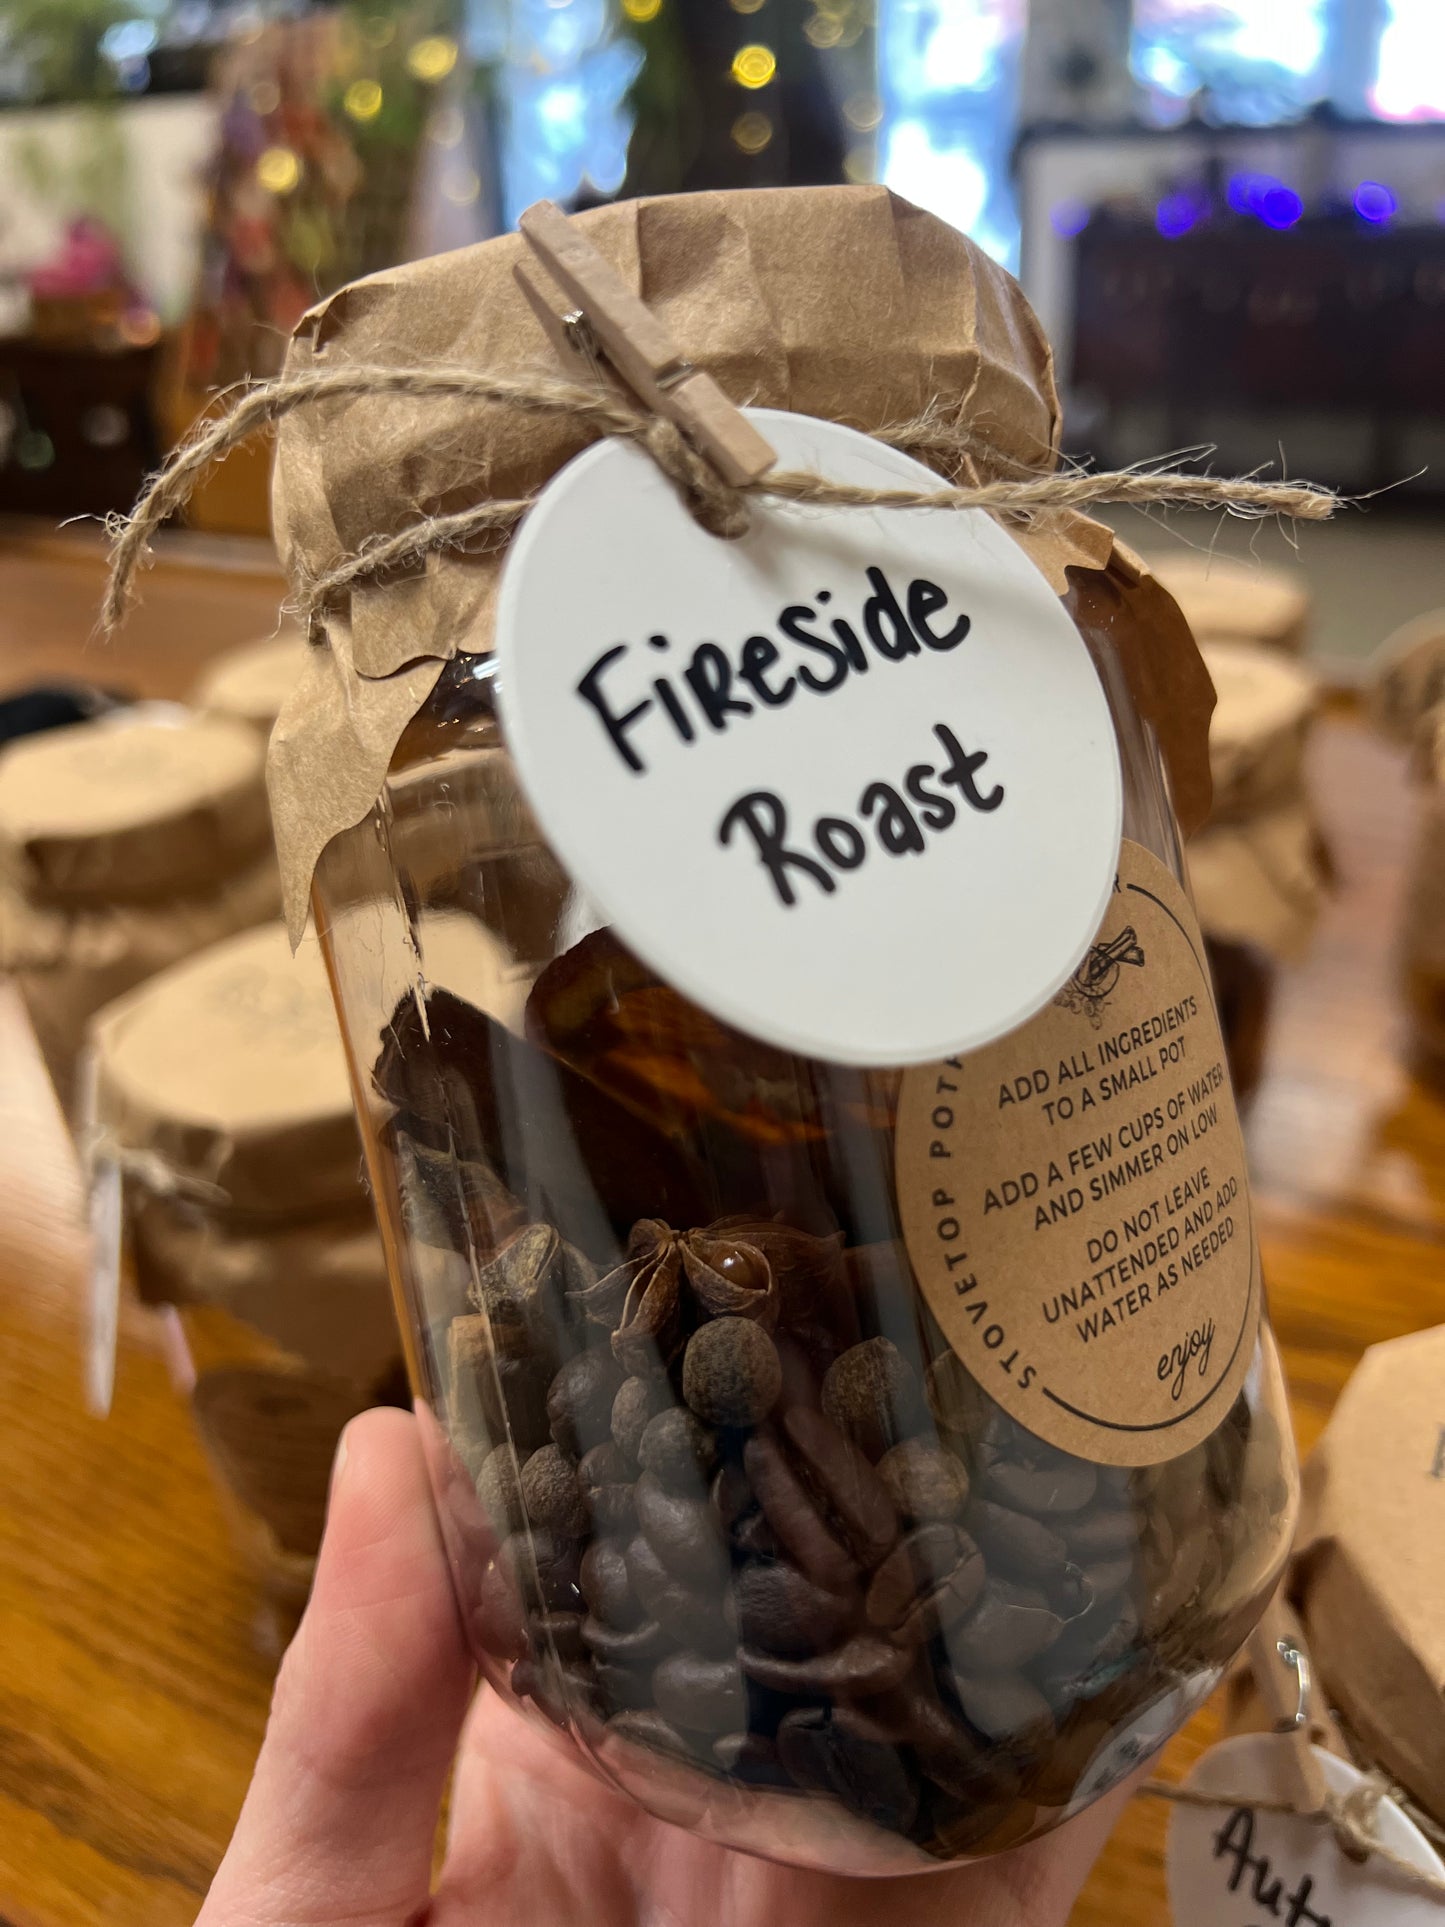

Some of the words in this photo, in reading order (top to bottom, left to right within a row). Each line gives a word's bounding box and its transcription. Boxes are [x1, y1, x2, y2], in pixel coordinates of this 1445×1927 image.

[718, 722, 1005, 908] Roast
[999, 1069, 1050, 1109] ADD
[1058, 1050, 1095, 1085] ALL
[1097, 994, 1198, 1066] INGREDIENTS
[1042, 1096, 1074, 1126] TO
[1081, 1087, 1096, 1112] A
[1099, 1056, 1158, 1101] SMALL
[1158, 1035, 1186, 1071] POT
[983, 1172, 1039, 1216] ADD
[1047, 1161, 1064, 1188] A
[1067, 1132, 1113, 1176] FEW
[1118, 1106, 1165, 1149] CUPS
[1166, 1091, 1185, 1121] OF
[1187, 1061, 1225, 1107] WATER
[1035, 1187, 1084, 1231] AND
[1089, 1142, 1165, 1202] SIMMER
[1166, 1124, 1190, 1156] ON
[1190, 1102, 1218, 1140] LOW
[1042, 1226, 1180, 1324] UNATTENDED
[1184, 1200, 1214, 1241] AND
[1216, 1176, 1238, 1214] ADD
[1087, 1229, 1119, 1264] DO
[1123, 1200, 1161, 1243] NOT
[1164, 1166, 1211, 1216] LEAVE
[932, 1188, 1038, 1390] STOVETOP
[1076, 1282, 1153, 1344] WATER
[1157, 1263, 1179, 1297] AS
[1180, 1216, 1235, 1278] NEEDED
[1157, 1317, 1216, 1402] enjoy
